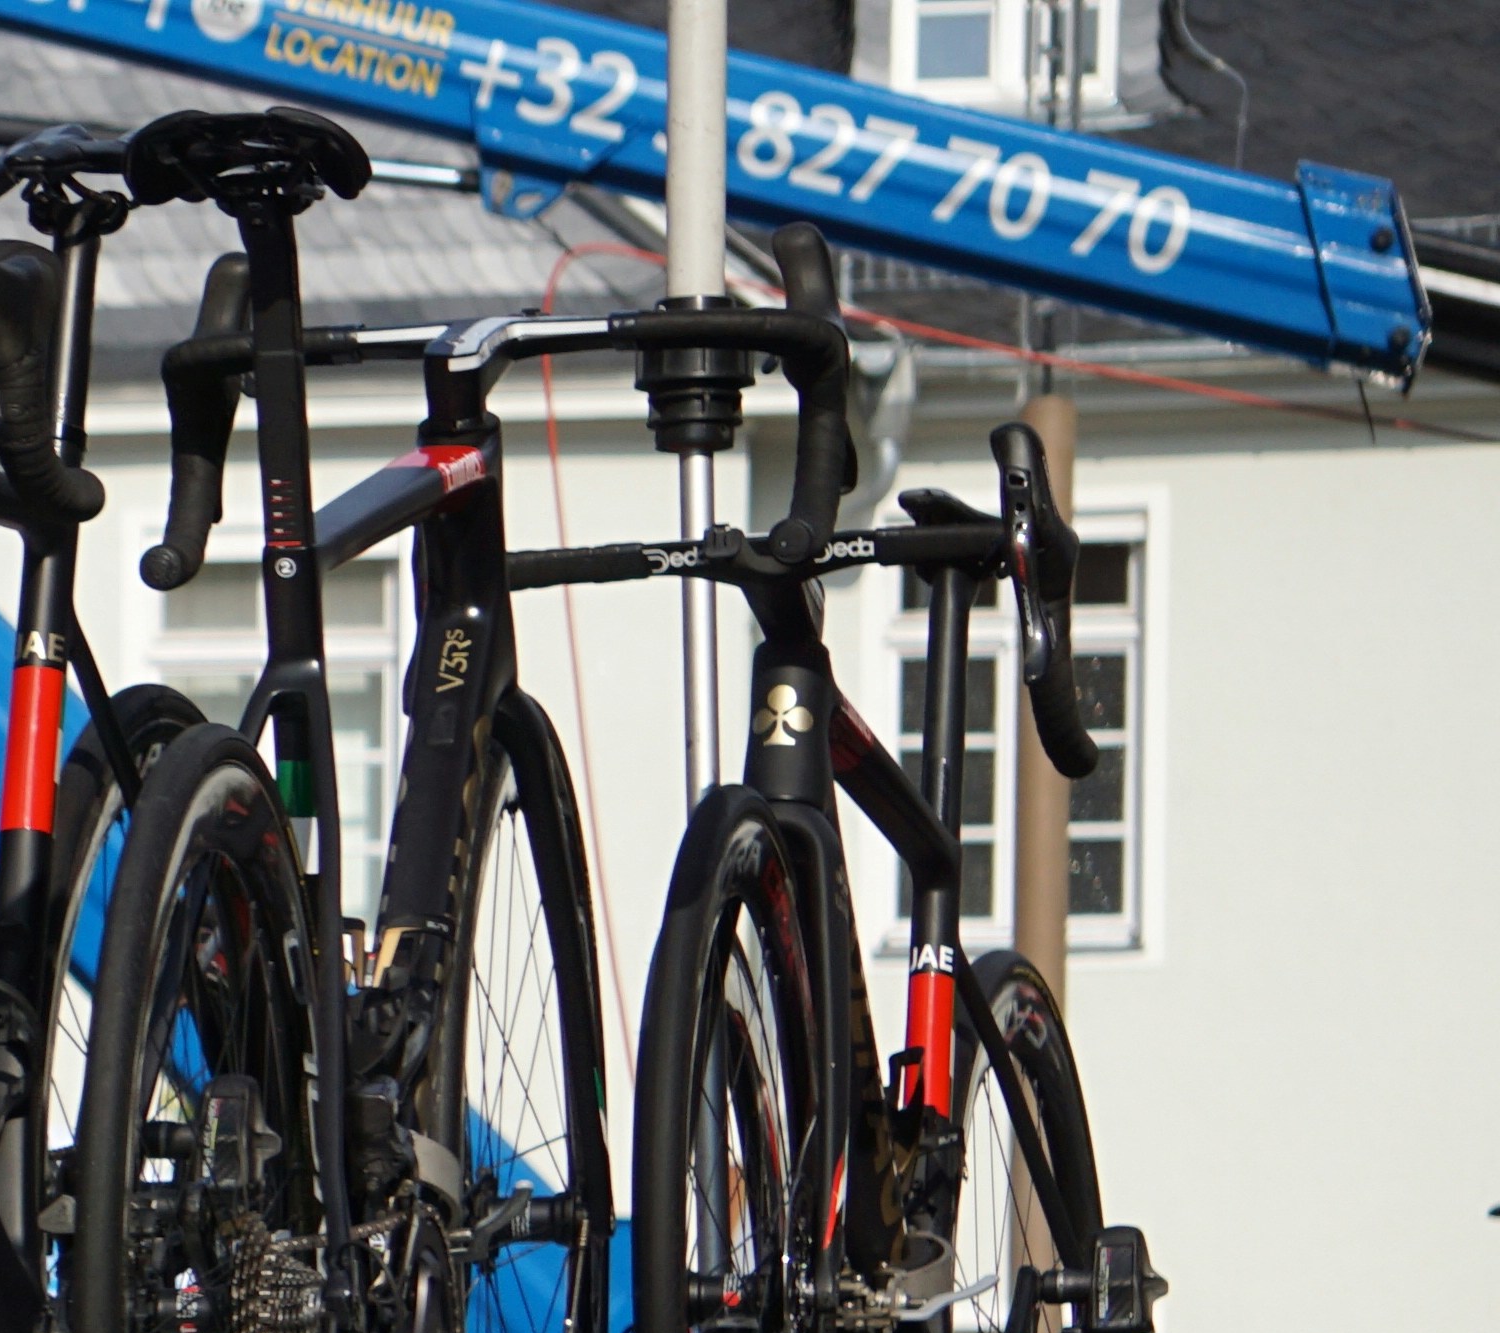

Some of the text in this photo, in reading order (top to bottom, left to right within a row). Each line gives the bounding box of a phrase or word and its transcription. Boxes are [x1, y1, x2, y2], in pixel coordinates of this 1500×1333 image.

[264, 23, 443, 98] LOCATION
[459, 37, 1192, 275] +32 827 70 70
[642, 547, 699, 574] Ded
[18, 630, 66, 663] AE
